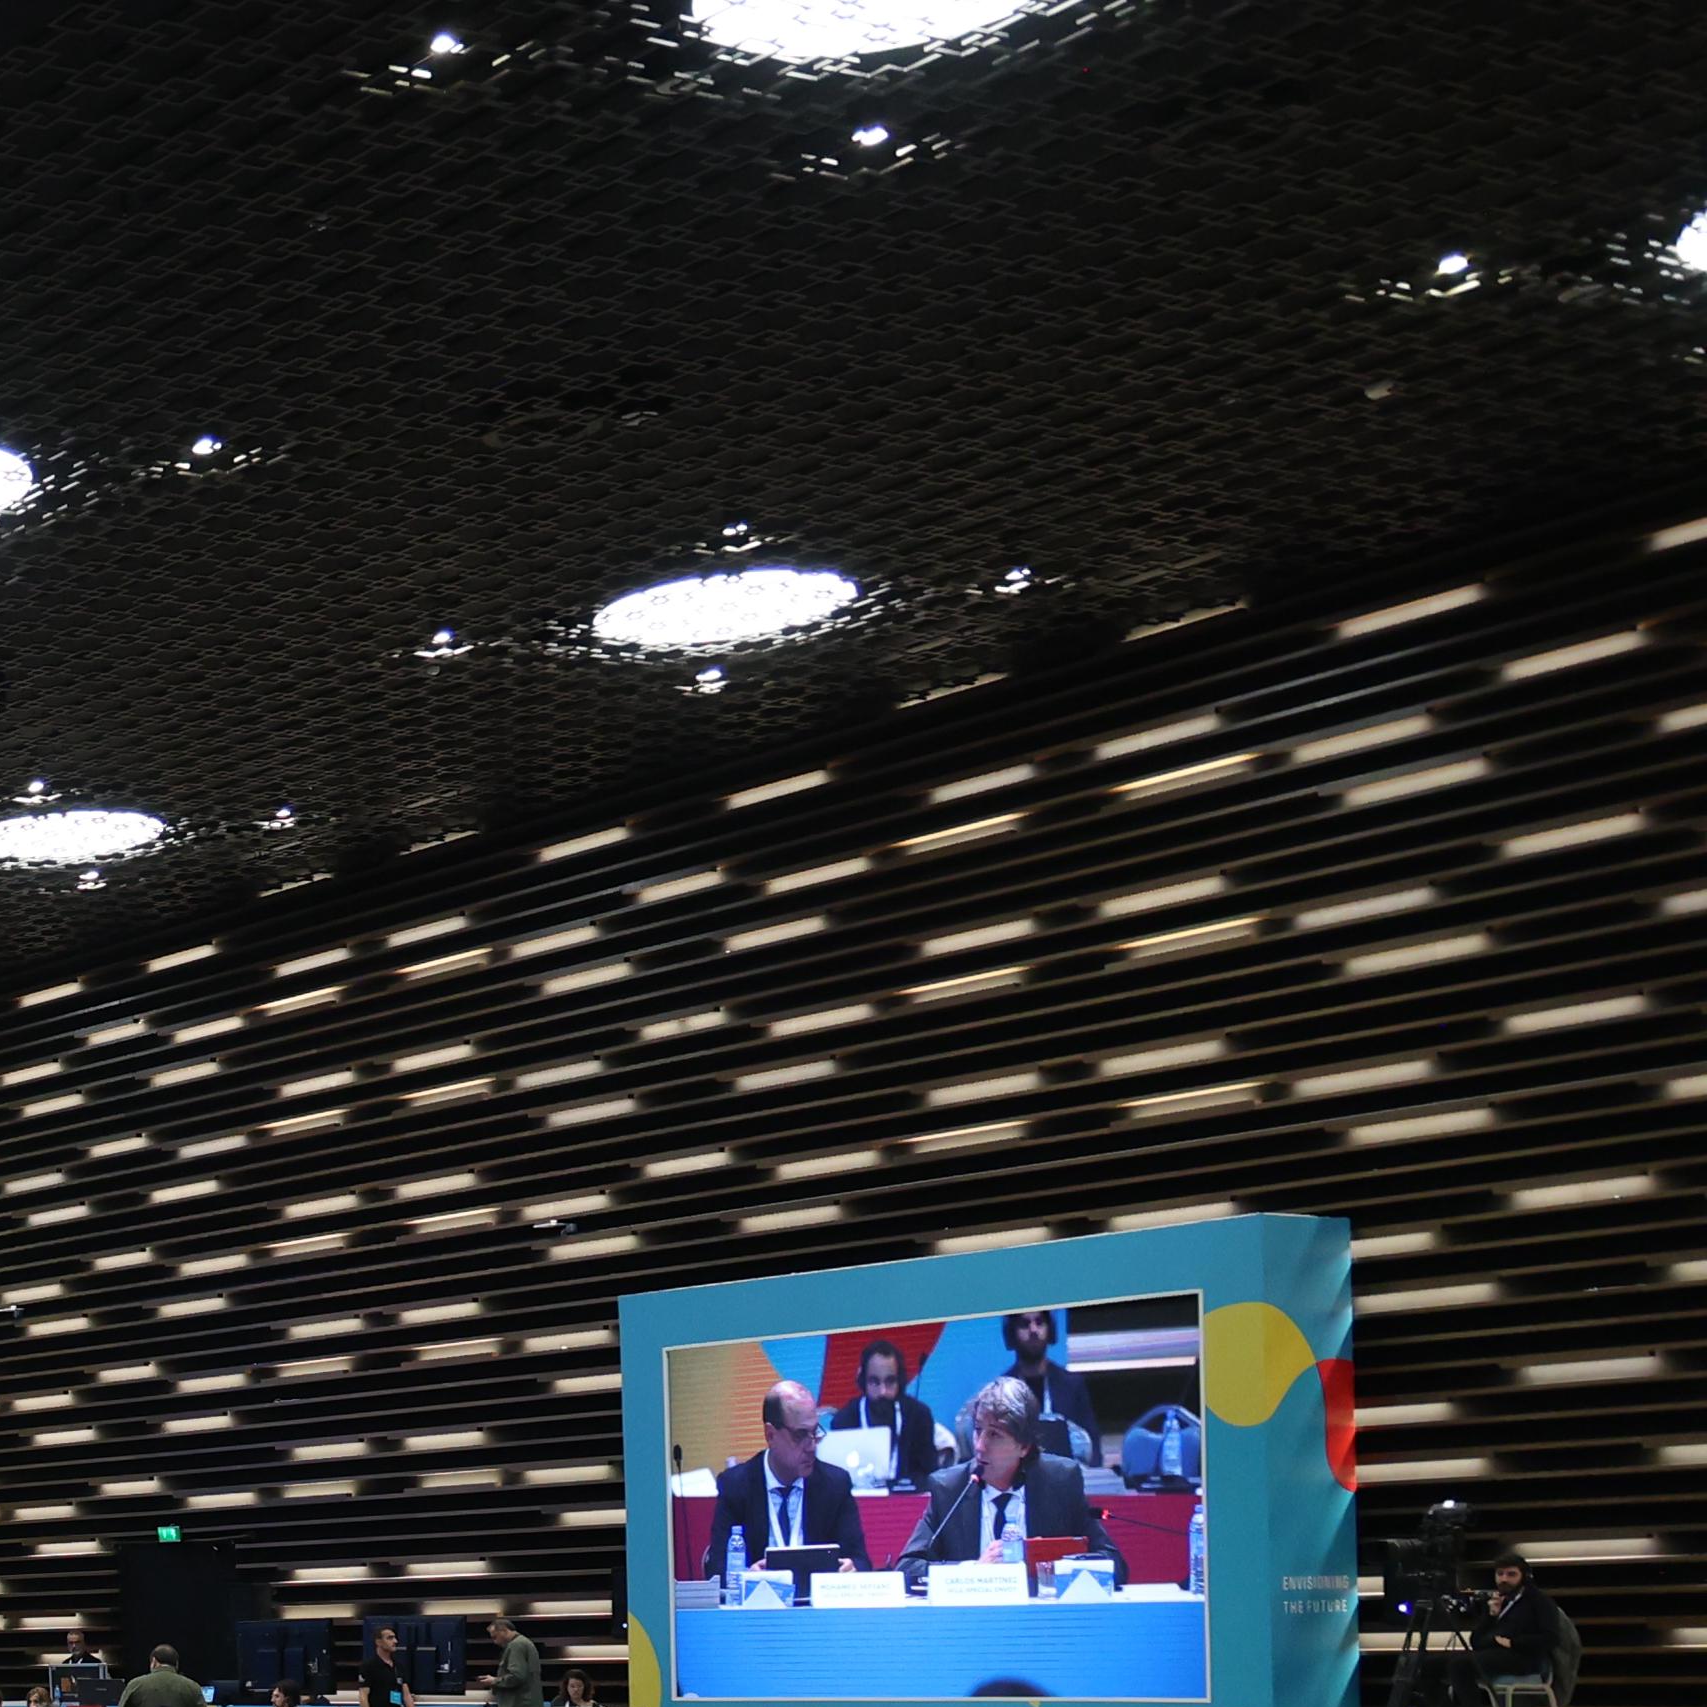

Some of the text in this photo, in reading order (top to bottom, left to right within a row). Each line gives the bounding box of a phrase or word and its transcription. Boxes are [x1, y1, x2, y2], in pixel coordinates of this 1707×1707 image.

[1282, 1575, 1349, 1591] ENVISIONING
[1283, 1599, 1348, 1614] THE FUTURE
